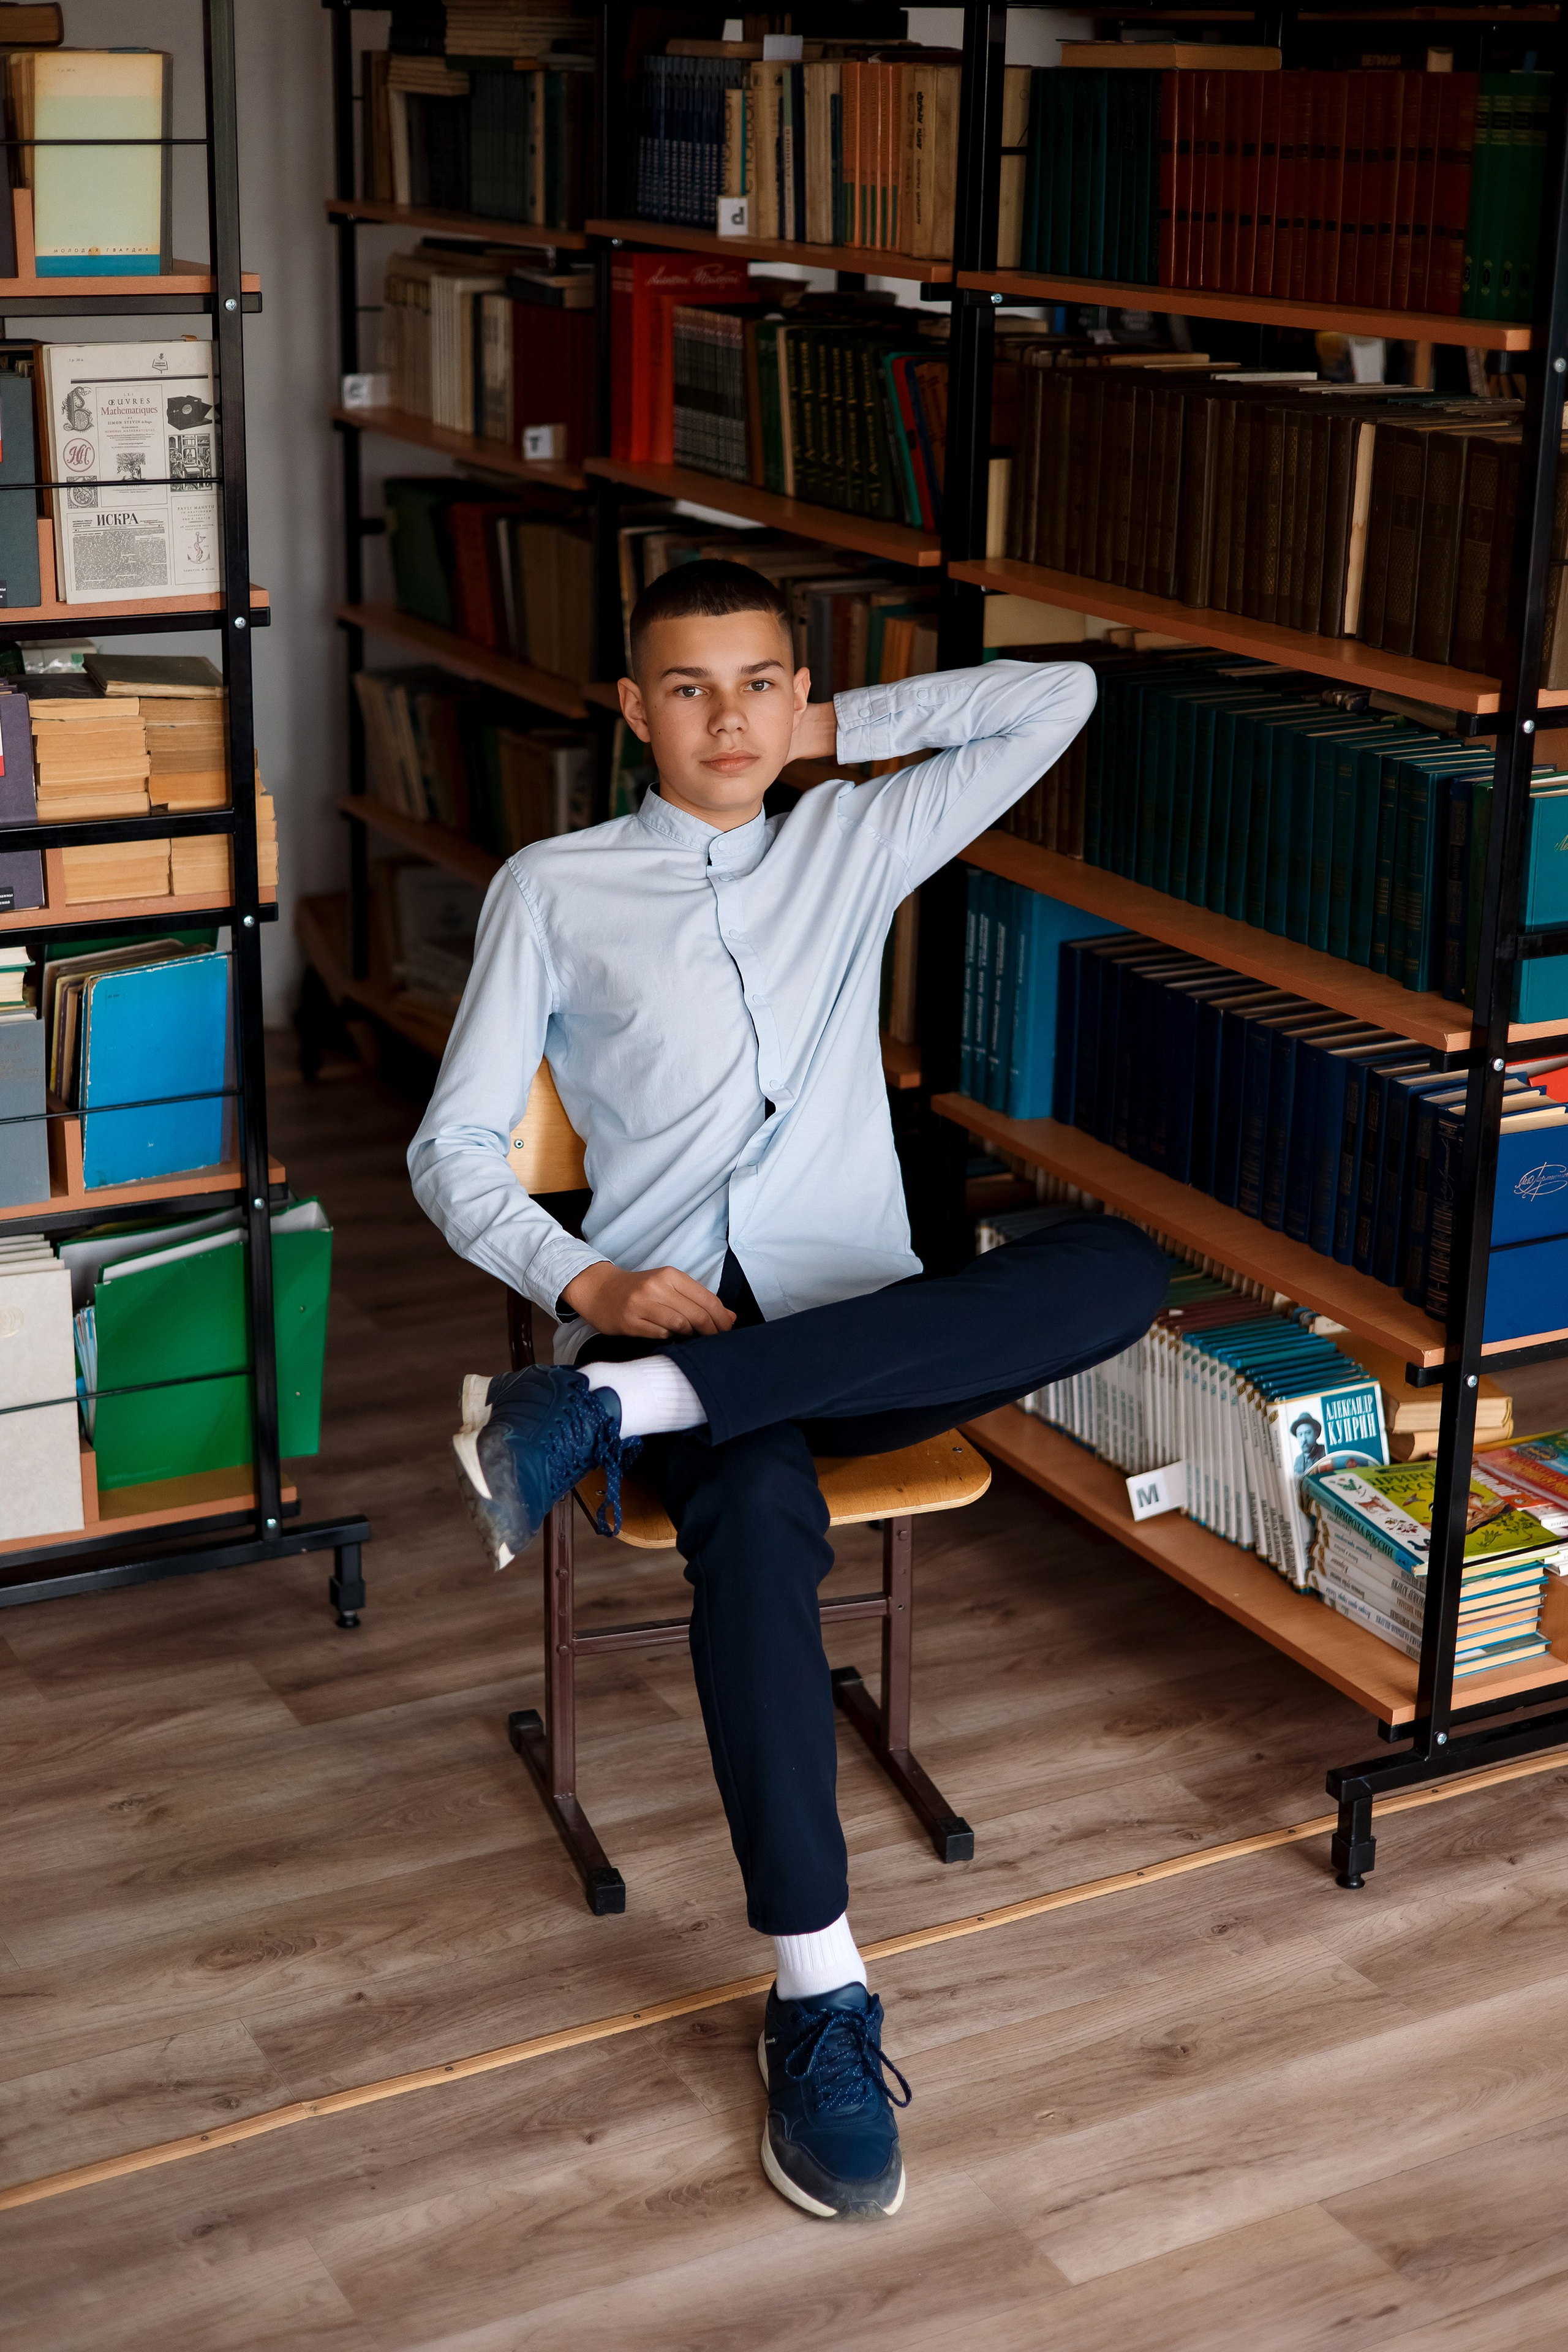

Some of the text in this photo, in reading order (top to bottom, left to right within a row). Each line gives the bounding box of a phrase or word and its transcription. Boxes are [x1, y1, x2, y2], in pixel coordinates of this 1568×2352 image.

[100, 405, 158, 416] Mathematiques
[96, 513, 140, 527] ИСКРА
[1325, 1393, 1373, 1421] АЛЕКСАНДР
[1327, 1412, 1378, 1446] КУПРИН
[1368, 1471, 1437, 1487] ПРИРО
[1379, 1480, 1436, 1495] РОСС
[1136, 1483, 1159, 1508] М
[1333, 1504, 1365, 1534] ПРИРОДА
[1364, 1529, 1394, 1558] РОССИИ
